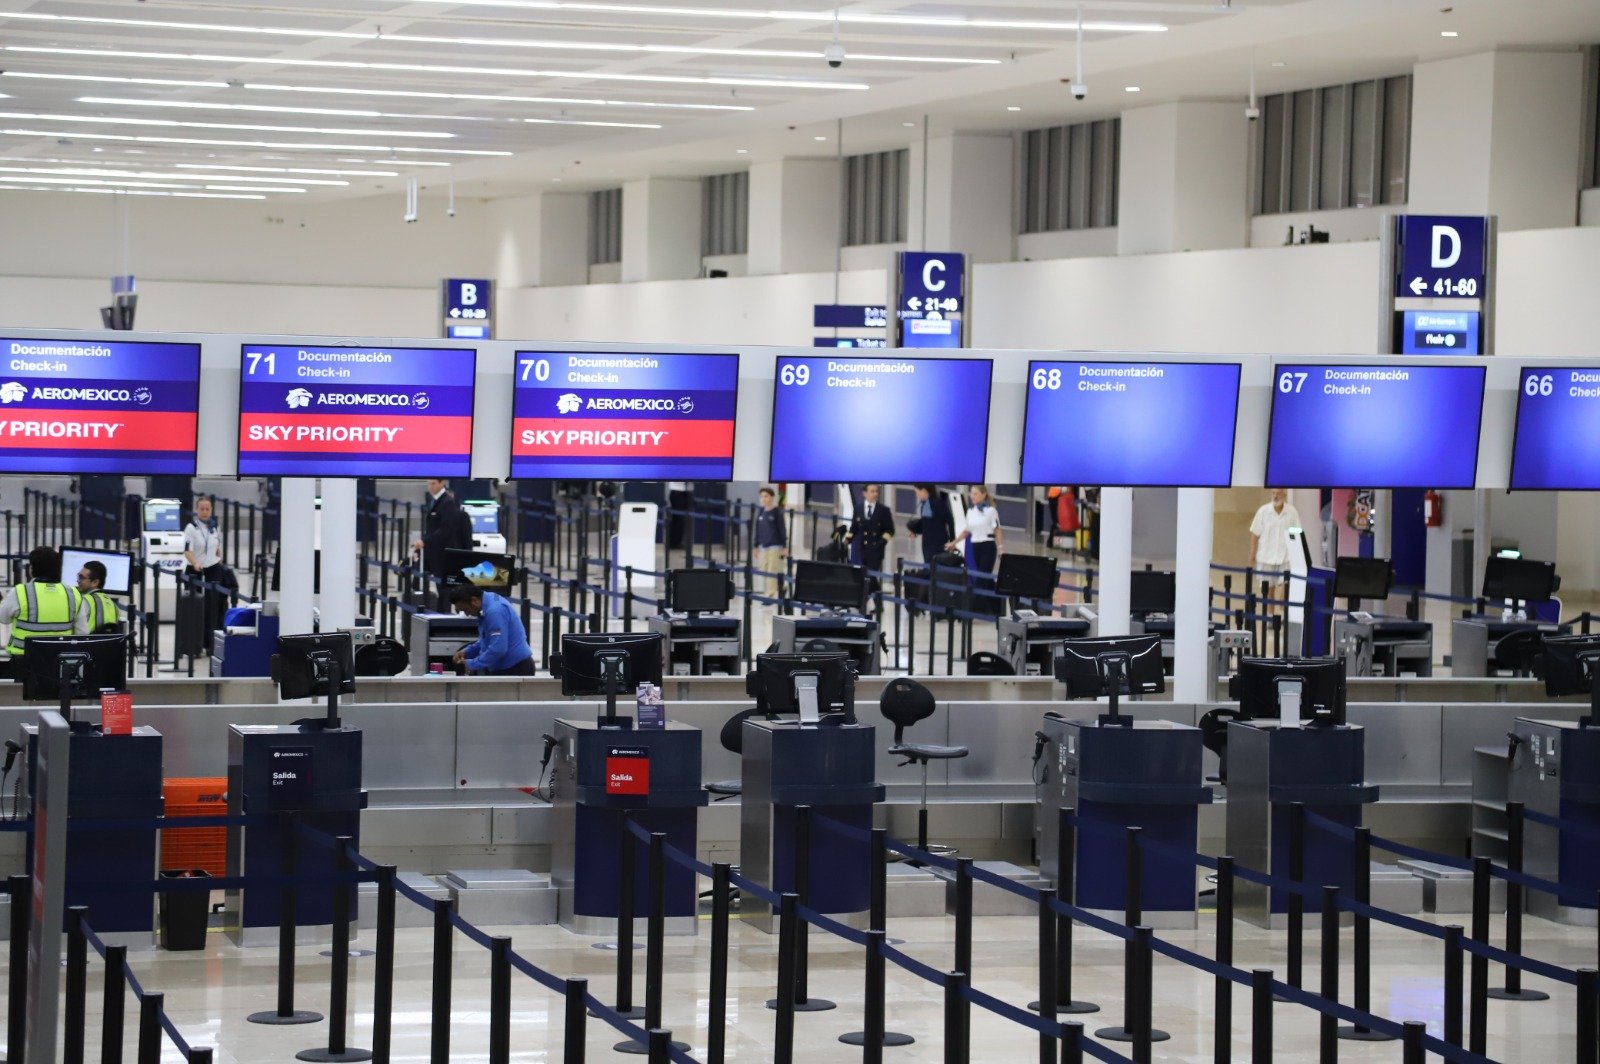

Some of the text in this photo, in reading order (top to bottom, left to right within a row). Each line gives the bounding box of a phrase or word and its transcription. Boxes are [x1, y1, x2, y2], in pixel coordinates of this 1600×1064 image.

[1431, 224, 1462, 269] D
[922, 258, 946, 293] C
[1433, 277, 1477, 296] 41-60
[461, 282, 477, 306] B
[924, 297, 959, 311] 21-40
[10, 343, 111, 357] Documentación
[297, 350, 392, 363] Documentación
[10, 359, 68, 372] Check-in
[246, 352, 276, 375] 71
[568, 357, 658, 369] Documentación
[828, 362, 914, 373] Documentación
[297, 366, 351, 378] Check-in
[519, 359, 550, 381] 70
[780, 364, 810, 386] 69
[1079, 366, 1164, 377] Documentación
[1325, 370, 1409, 380] Documentación
[567, 372, 619, 384] Check-in
[827, 377, 876, 387] Check-in
[1032, 368, 1062, 390] 68
[1279, 372, 1308, 393] 67
[1078, 381, 1126, 392] Check-in
[1324, 384, 1371, 394] Check-in
[1525, 374, 1553, 396] 66
[272, 771, 297, 779] Salida
[611, 773, 633, 781] Salida
